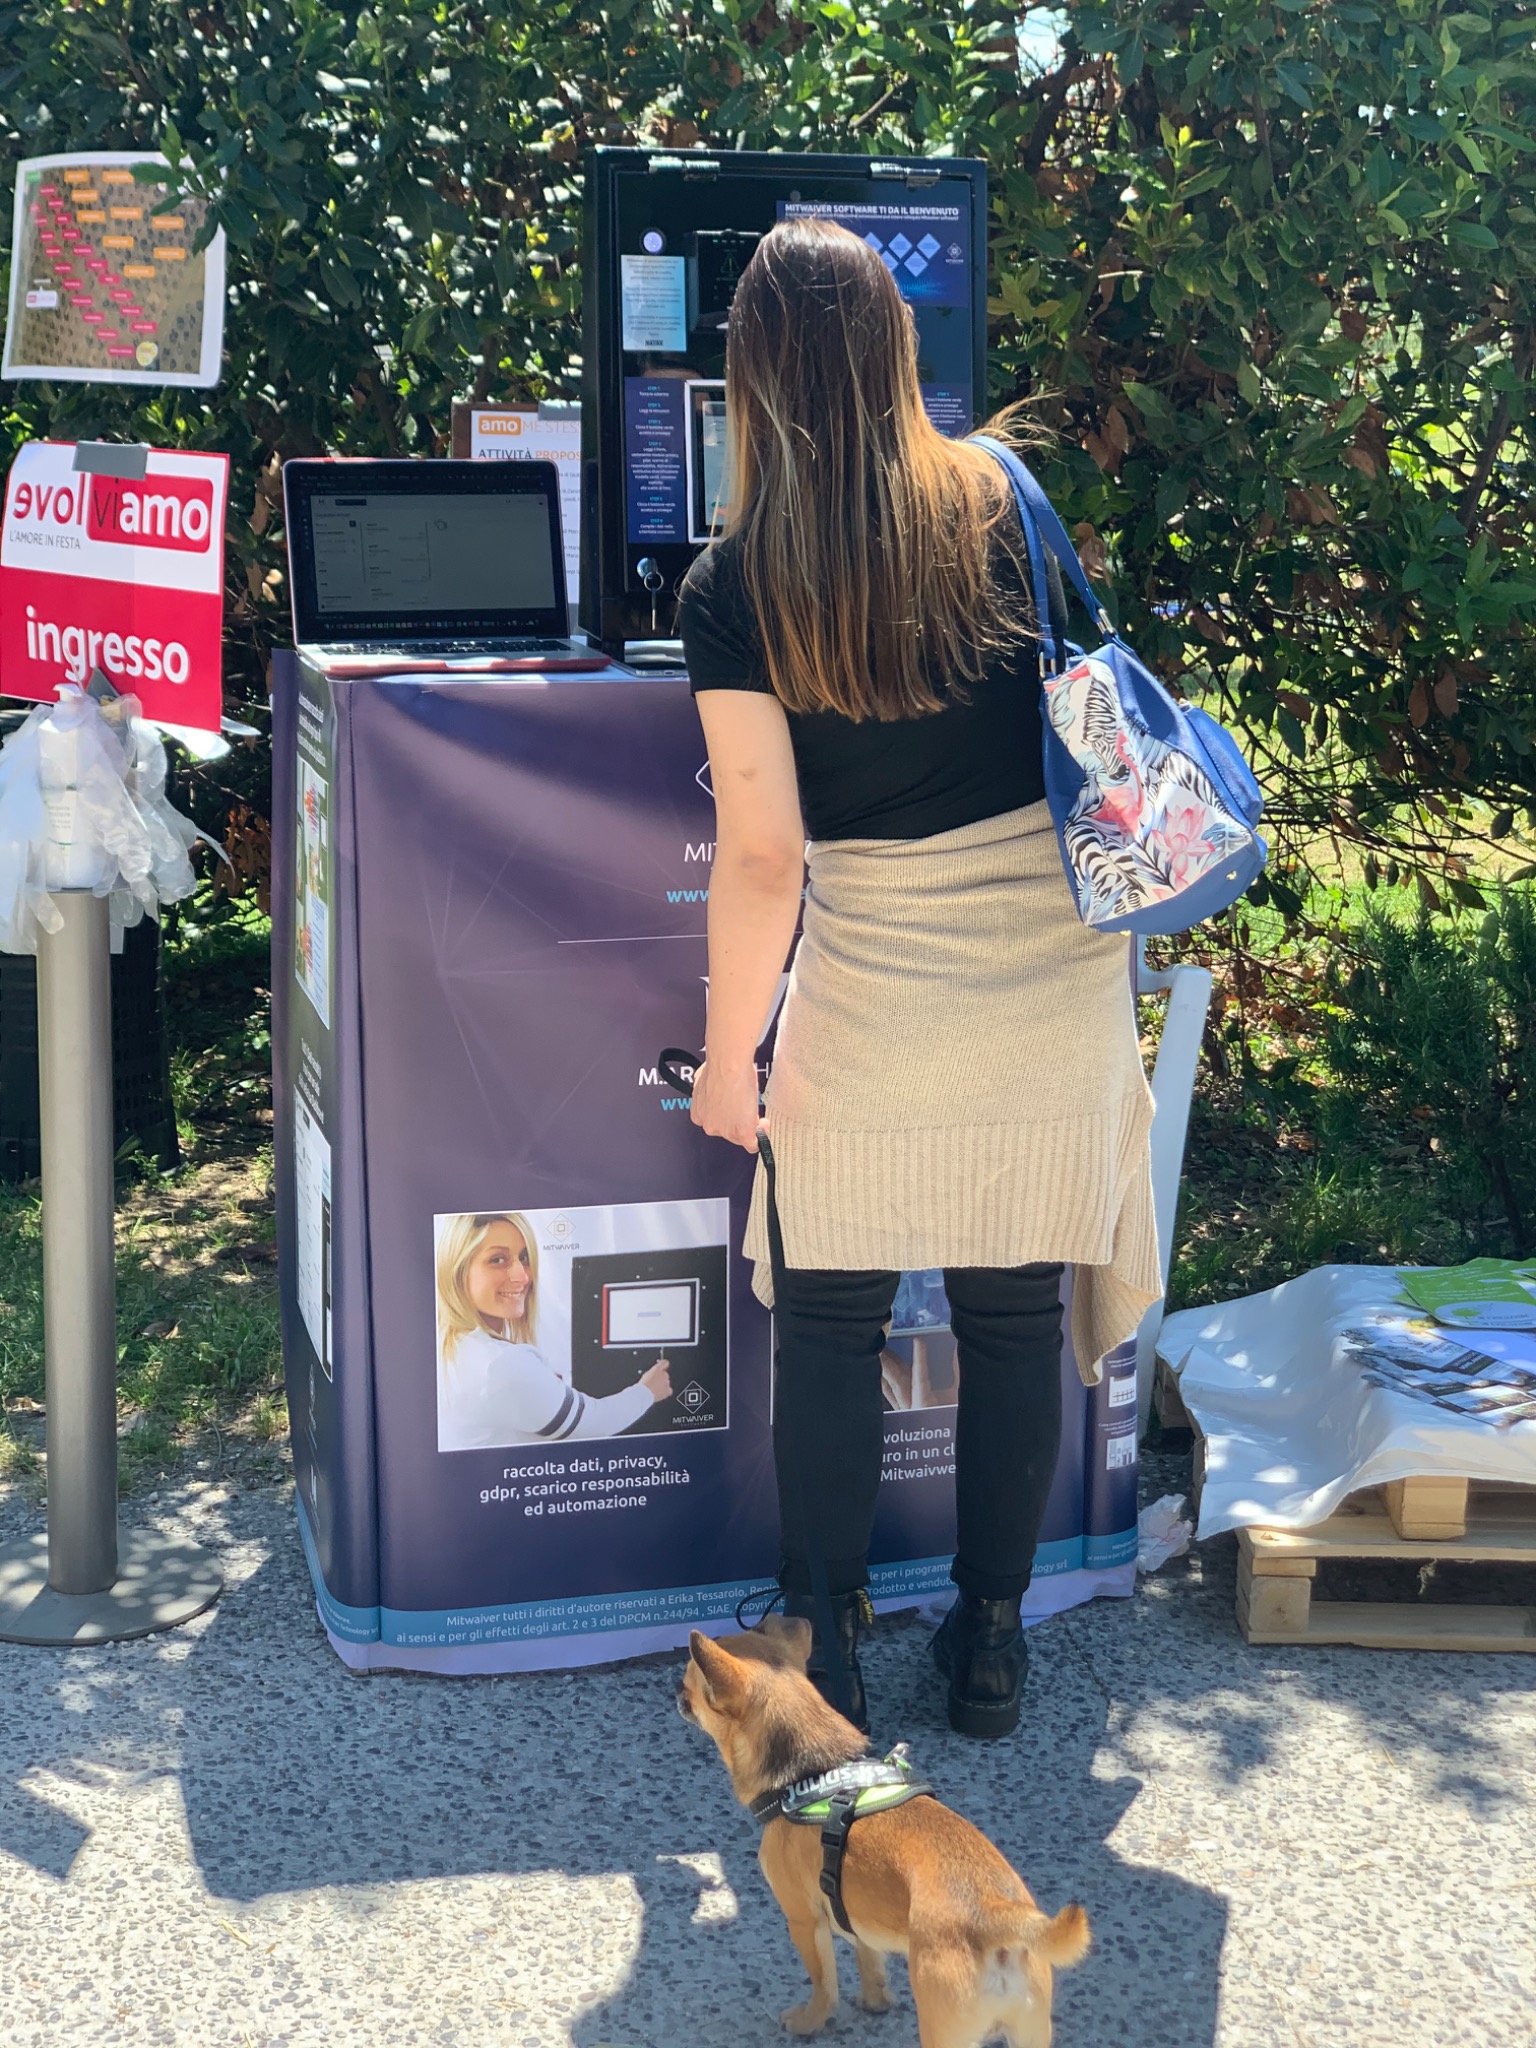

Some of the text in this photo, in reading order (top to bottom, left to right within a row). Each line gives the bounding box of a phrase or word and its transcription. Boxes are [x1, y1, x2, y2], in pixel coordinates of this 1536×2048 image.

[785, 204, 959, 216] MITWAIVER SOFTWARE TI DA IL BENVENUTO
[481, 418, 518, 432] amo
[545, 421, 580, 433] STES
[478, 447, 532, 459] ATTIVITÀ
[9, 530, 81, 550] L'AMORE IN FESTA
[26, 605, 189, 684] ingresso
[543, 1243, 580, 1251] MITWAIVER
[672, 1414, 714, 1424] MITWAIVER
[905, 1448, 918, 1460] in
[922, 1447, 939, 1459] un
[503, 1455, 667, 1479] raccolta dati, privacy,
[480, 1469, 690, 1503] gdpr, scarico responsabilità
[524, 1498, 647, 1516] ed automazione
[397, 1633, 406, 1643] ai
[408, 1632, 436, 1643] sensi
[439, 1633, 445, 1642] e
[448, 1633, 466, 1644] per
[469, 1629, 482, 1642] gli
[485, 1626, 520, 1639] effetti
[522, 1624, 549, 1637] degli
[551, 1621, 570, 1632] art.
[572, 1619, 578, 1629] 2
[591, 1617, 597, 1628] 3
[600, 1615, 617, 1626] del
[619, 1612, 651, 1625] DPCM
[653, 1608, 699, 1622] n.244/94
[707, 1604, 733, 1616] SIAE,
[1056, 1559, 1067, 1570] srl
[447, 1613, 500, 1627] Mitwaiver
[503, 1609, 527, 1622] tutti
[535, 1607, 565, 1619] diritti
[567, 1602, 611, 1615] d'autore
[614, 1597, 657, 1610] riservati
[659, 1598, 666, 1606] a
[668, 1593, 694, 1605] Erika
[696, 1588, 748, 1603] Tessarolo,
[881, 1569, 897, 1581] per
